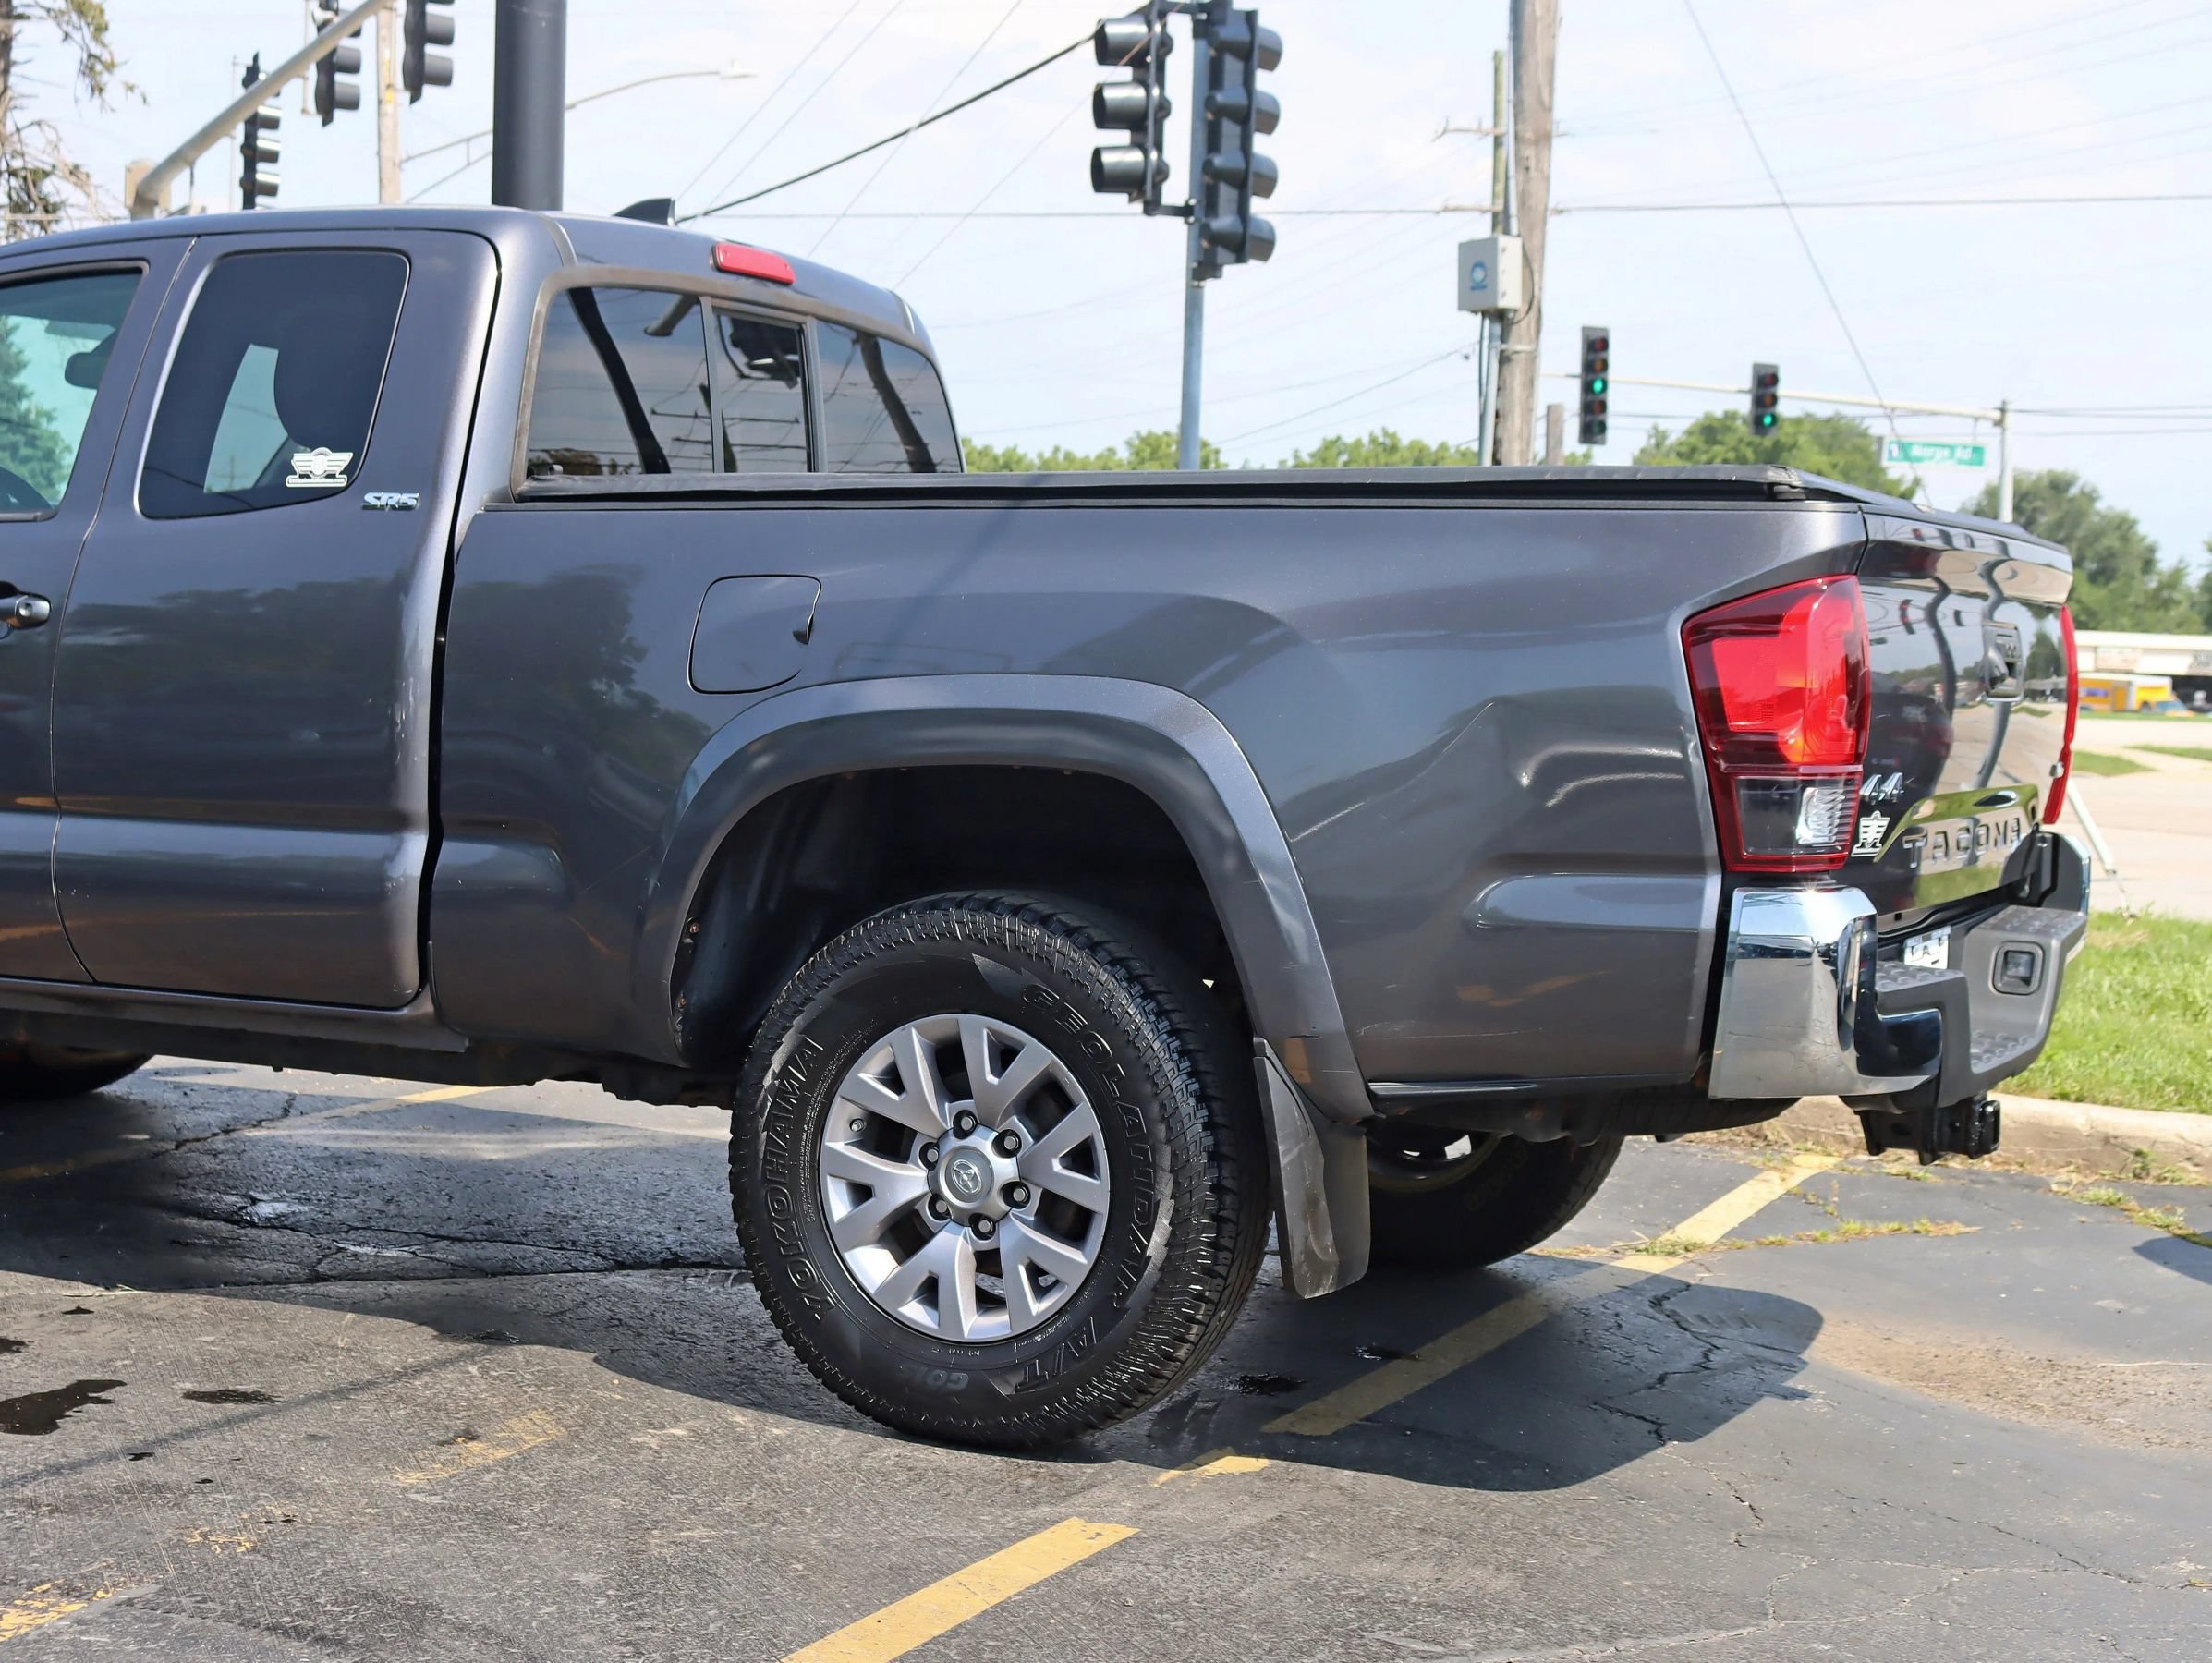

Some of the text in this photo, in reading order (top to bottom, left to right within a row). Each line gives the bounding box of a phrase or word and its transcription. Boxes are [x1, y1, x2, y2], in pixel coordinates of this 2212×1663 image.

[364, 492, 419, 508] SR5
[1903, 817, 2022, 868] TACOMA
[766, 1036, 836, 1321] YOKOHAMA
